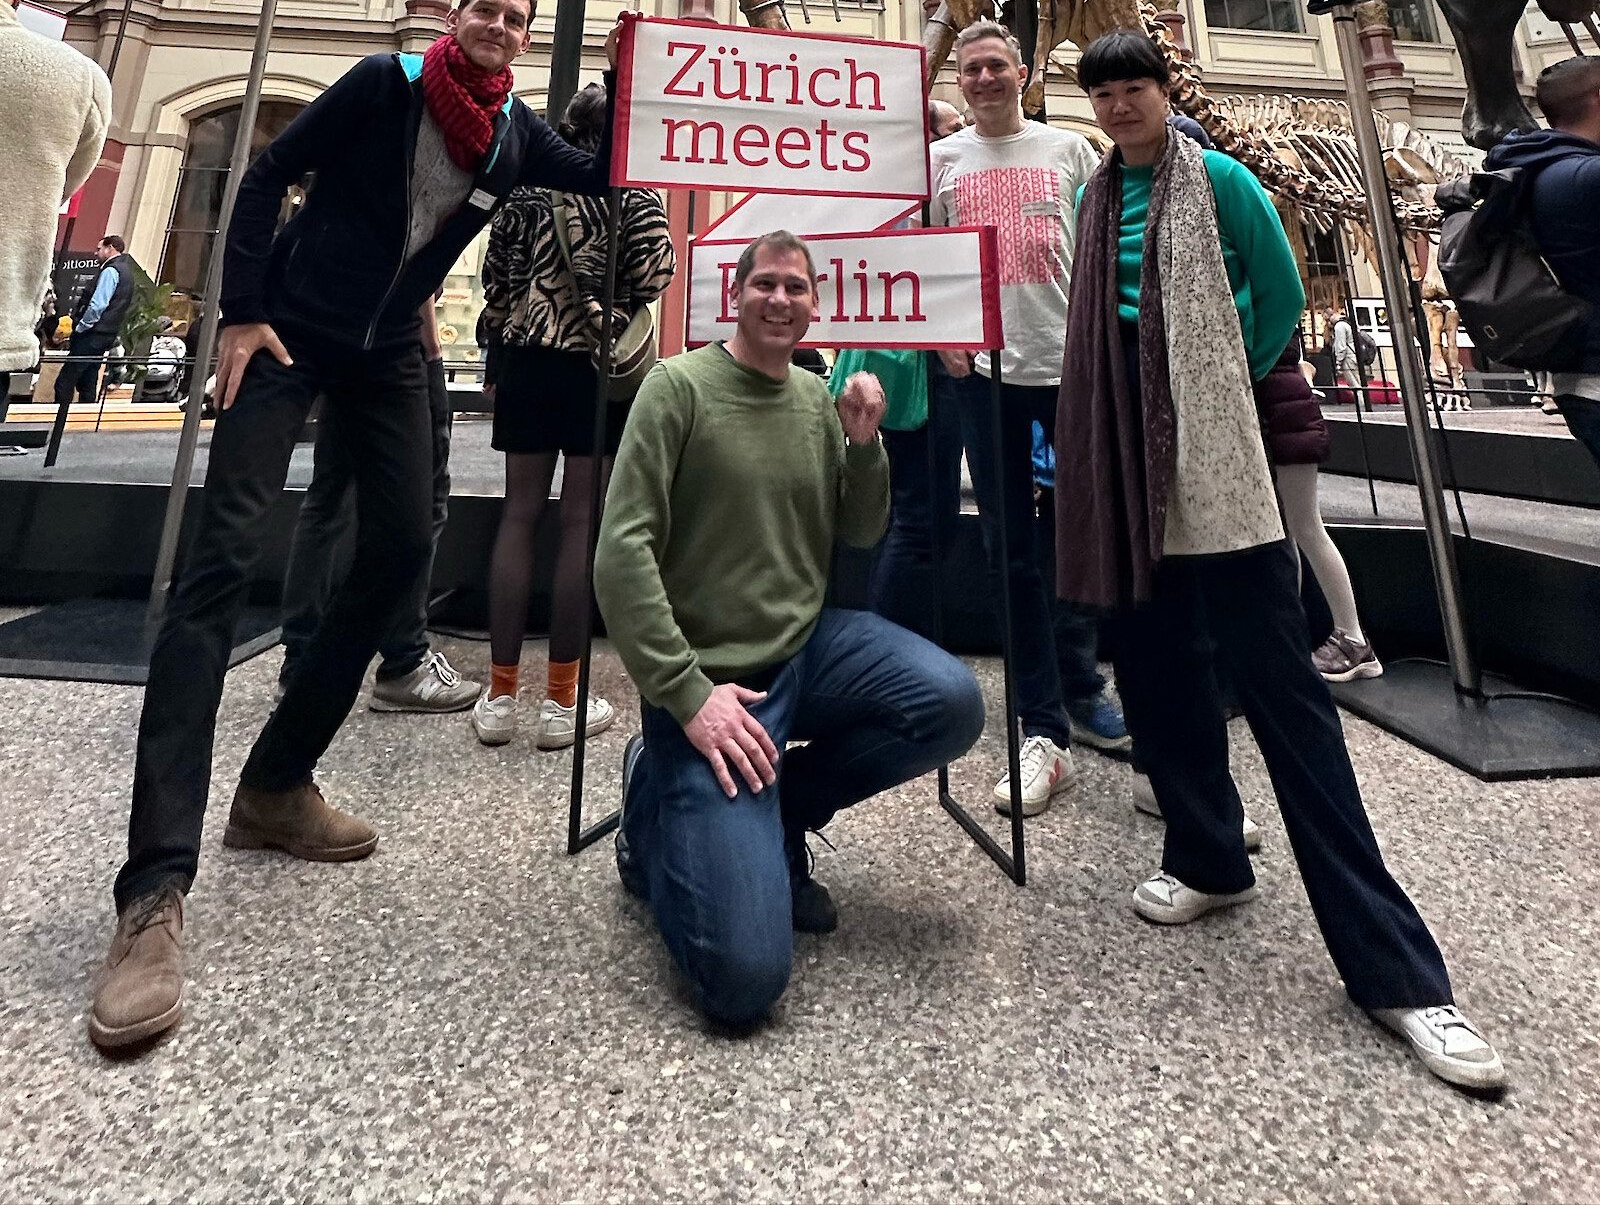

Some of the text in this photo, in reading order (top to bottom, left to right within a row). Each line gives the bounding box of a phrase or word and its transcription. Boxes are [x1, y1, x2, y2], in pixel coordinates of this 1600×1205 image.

[664, 41, 886, 111] Zürich
[660, 118, 871, 172] meets
[716, 258, 927, 322] lin
